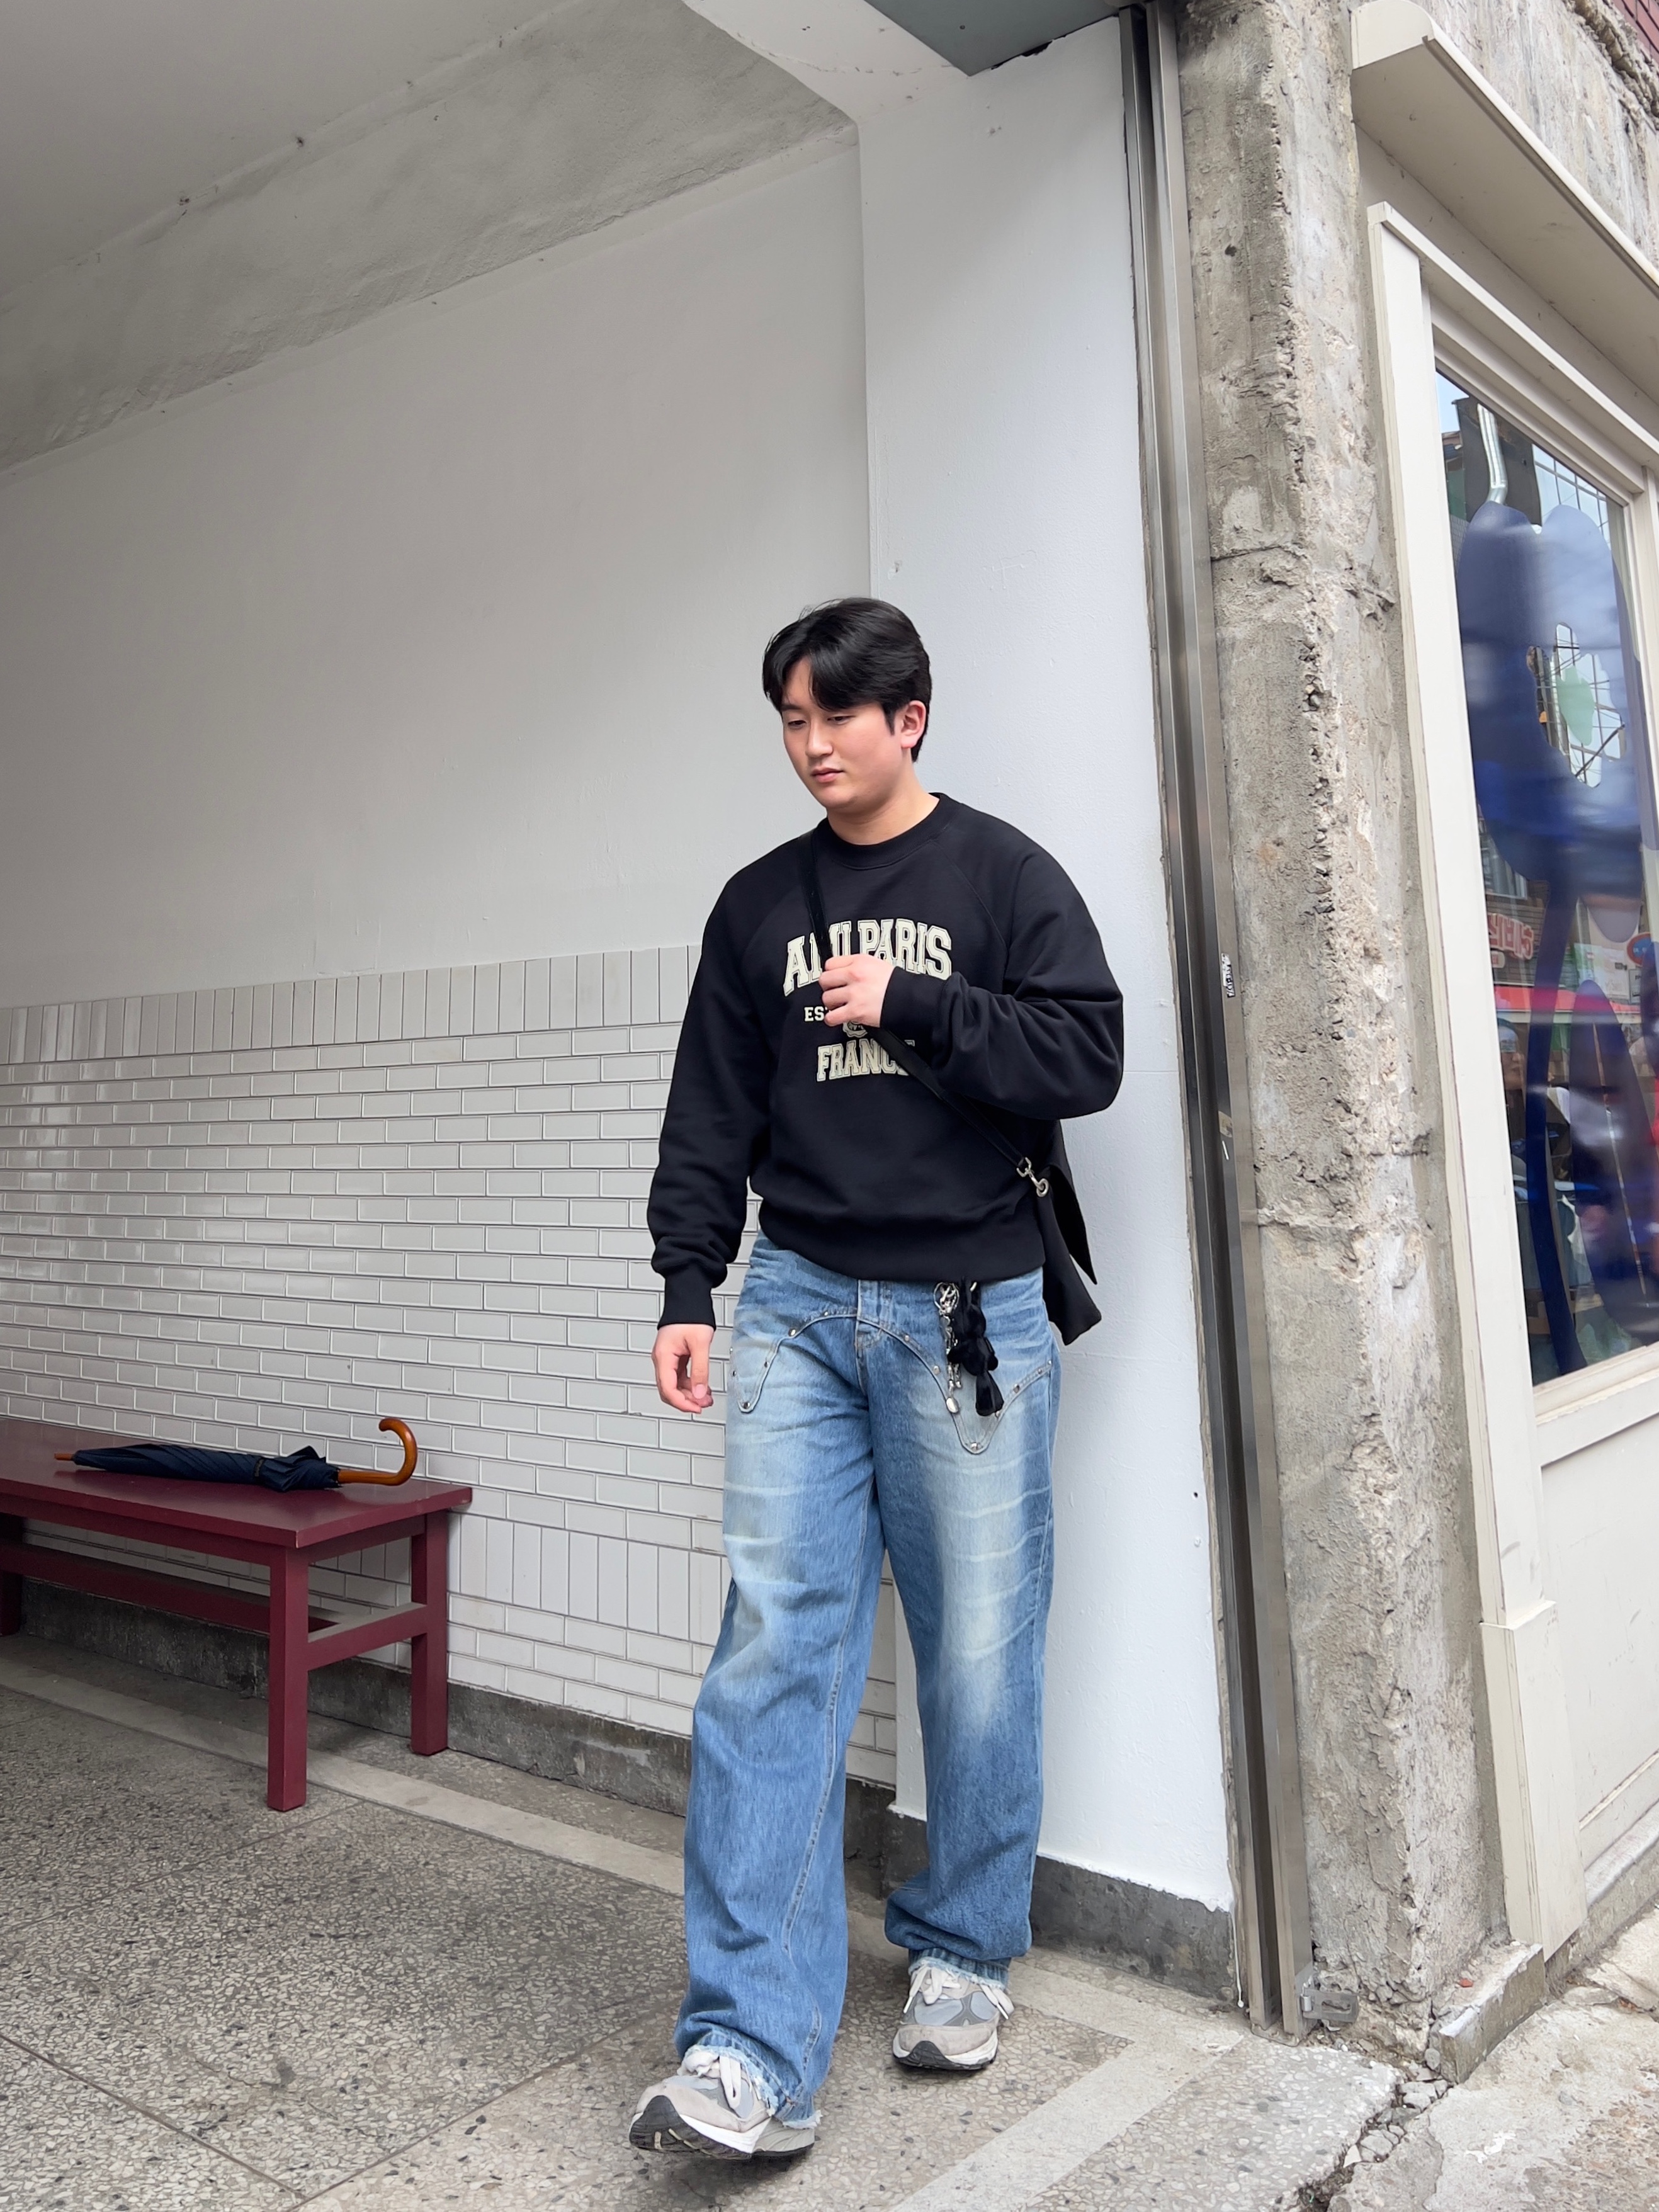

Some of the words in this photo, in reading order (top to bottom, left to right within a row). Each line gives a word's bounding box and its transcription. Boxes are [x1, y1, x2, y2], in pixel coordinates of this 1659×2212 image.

[858, 918, 952, 980] PARIS
[804, 1006, 829, 1021] ES
[817, 1038, 915, 1082] FRANC
